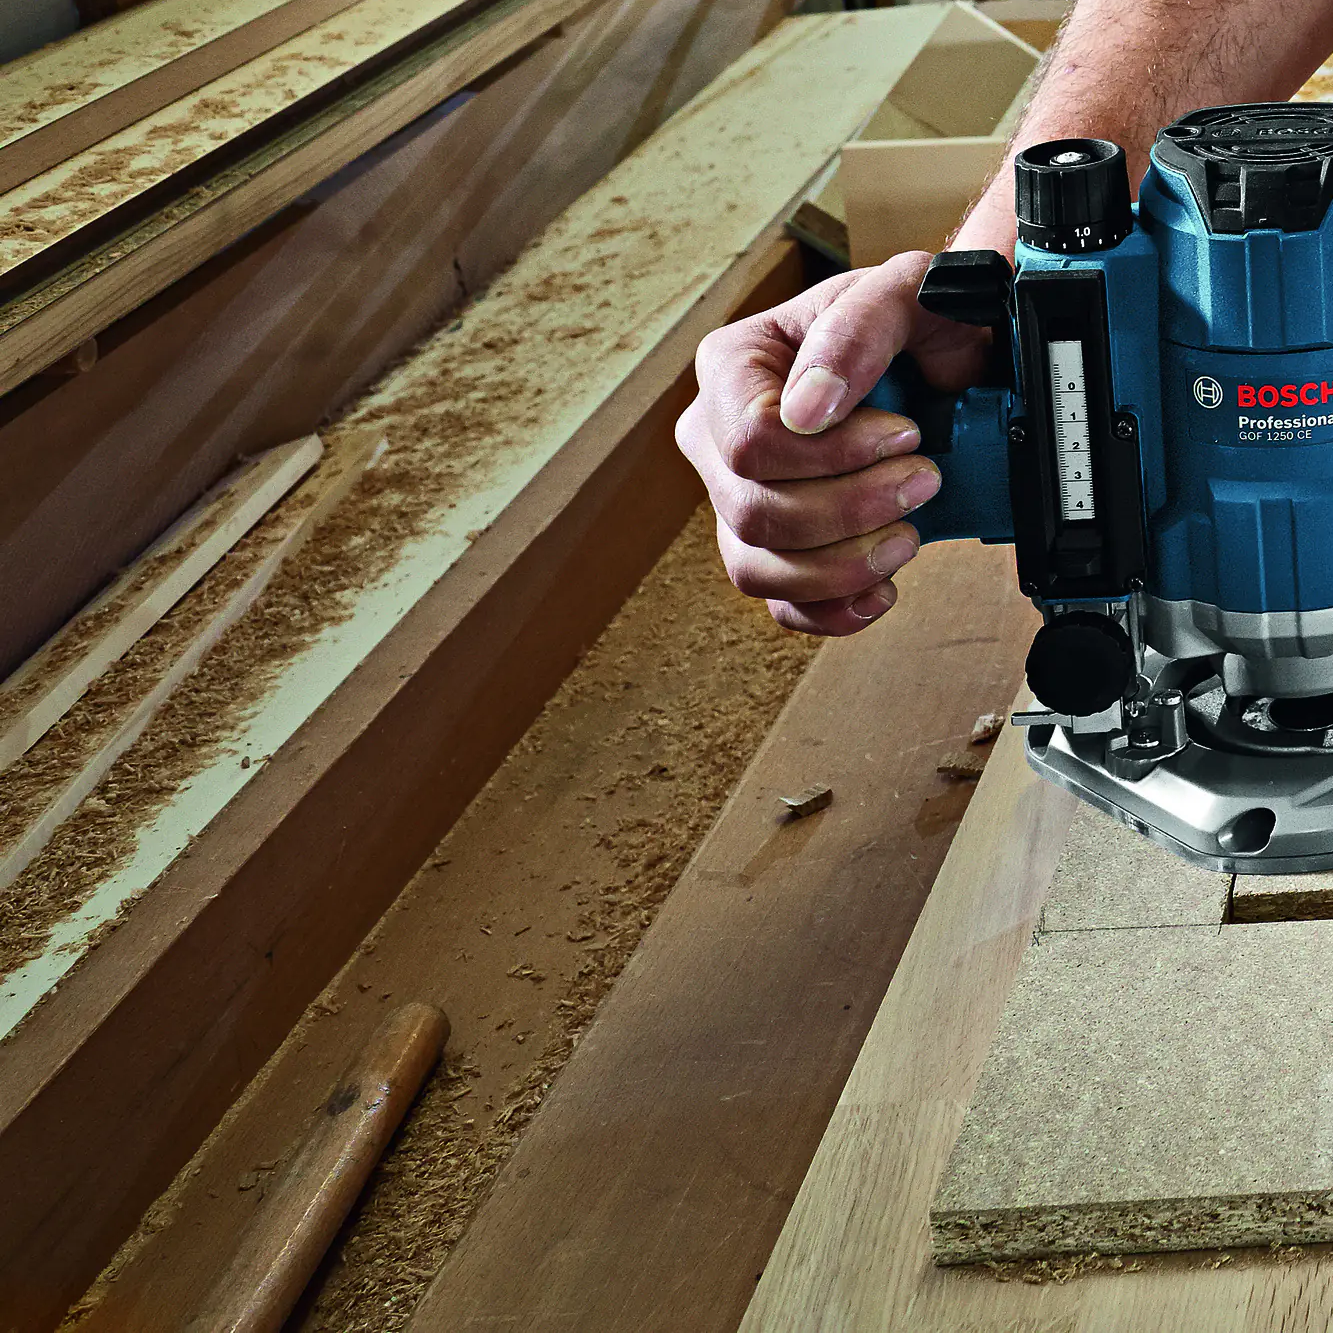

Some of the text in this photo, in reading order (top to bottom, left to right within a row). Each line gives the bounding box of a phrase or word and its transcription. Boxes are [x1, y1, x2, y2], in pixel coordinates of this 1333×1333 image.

[1074, 226, 1091, 238] 1.0
[1067, 382, 1076, 391] 0
[1070, 412, 1077, 421] 1
[1239, 429, 1312, 441] GOF 1250 CE
[1072, 442, 1081, 450] 2
[1074, 471, 1082, 480] 3
[1076, 501, 1084, 509] 4
